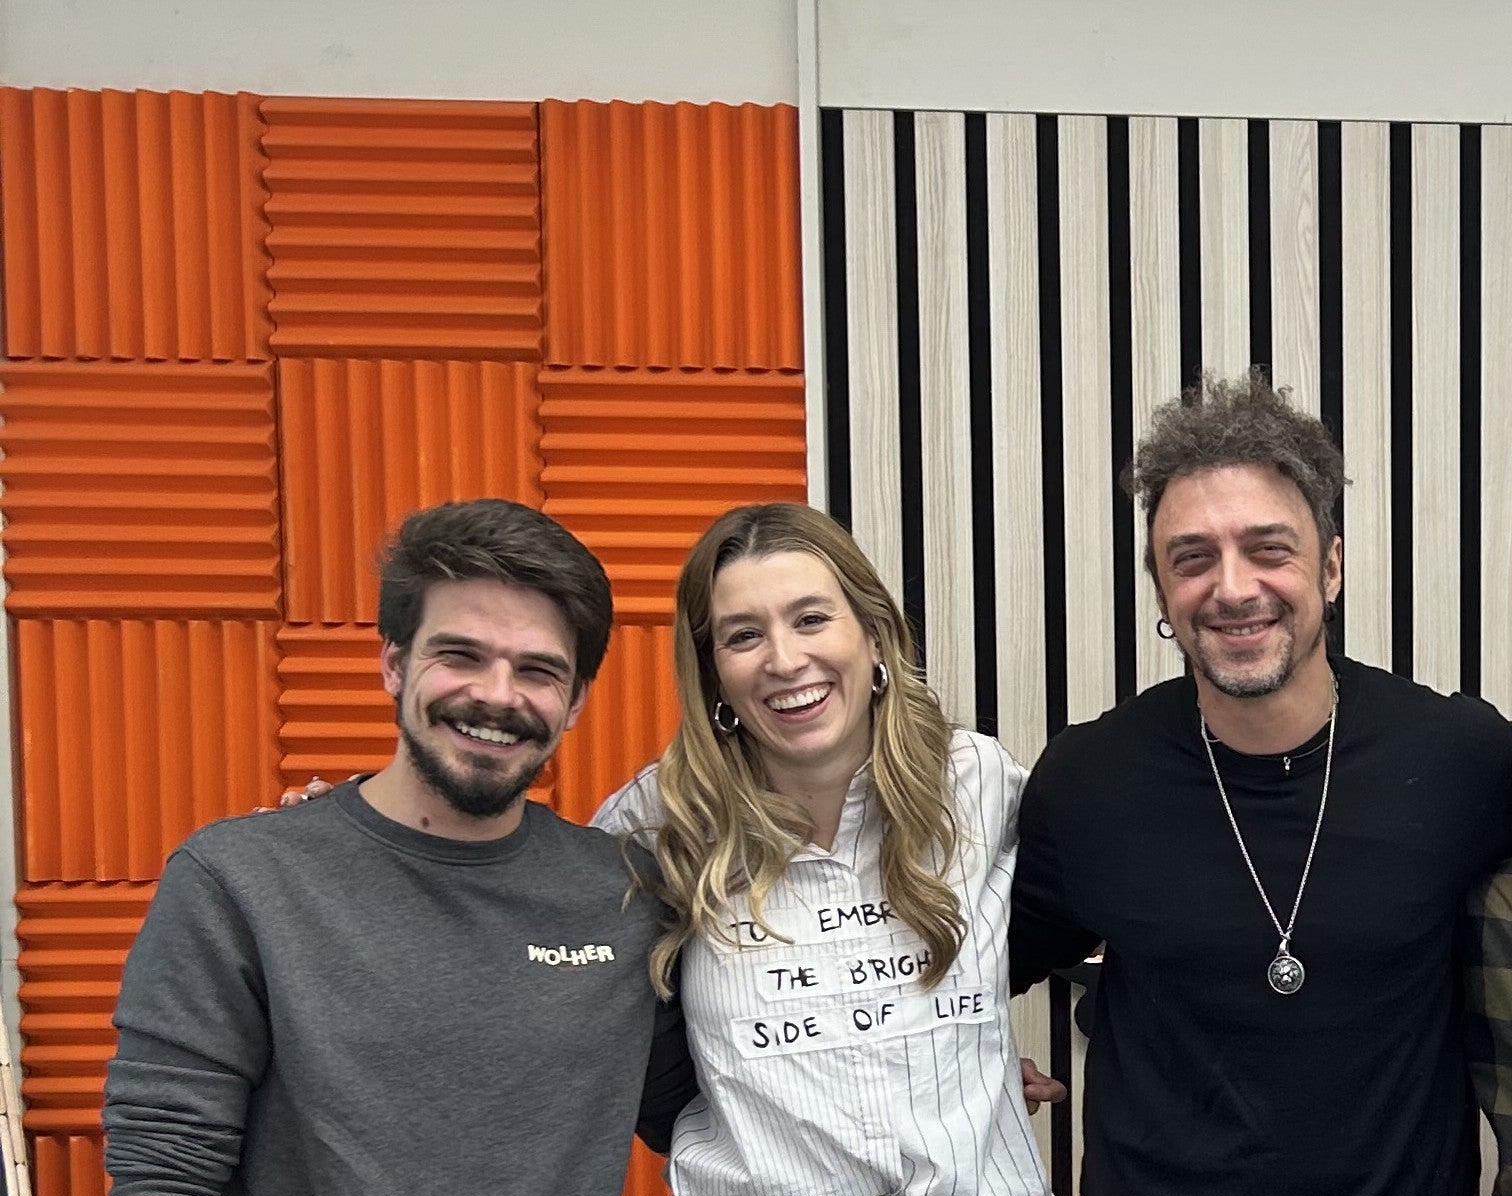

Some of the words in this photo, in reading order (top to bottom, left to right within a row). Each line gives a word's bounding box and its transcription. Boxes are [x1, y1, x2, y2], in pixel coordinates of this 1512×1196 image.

[817, 901, 898, 932] EMBR
[528, 945, 615, 965] WOLHER
[767, 966, 819, 990] THE
[846, 950, 931, 985] BRIGH
[752, 1017, 821, 1048] SIDE
[853, 1003, 895, 1031] OF
[935, 993, 984, 1019] LIFE
